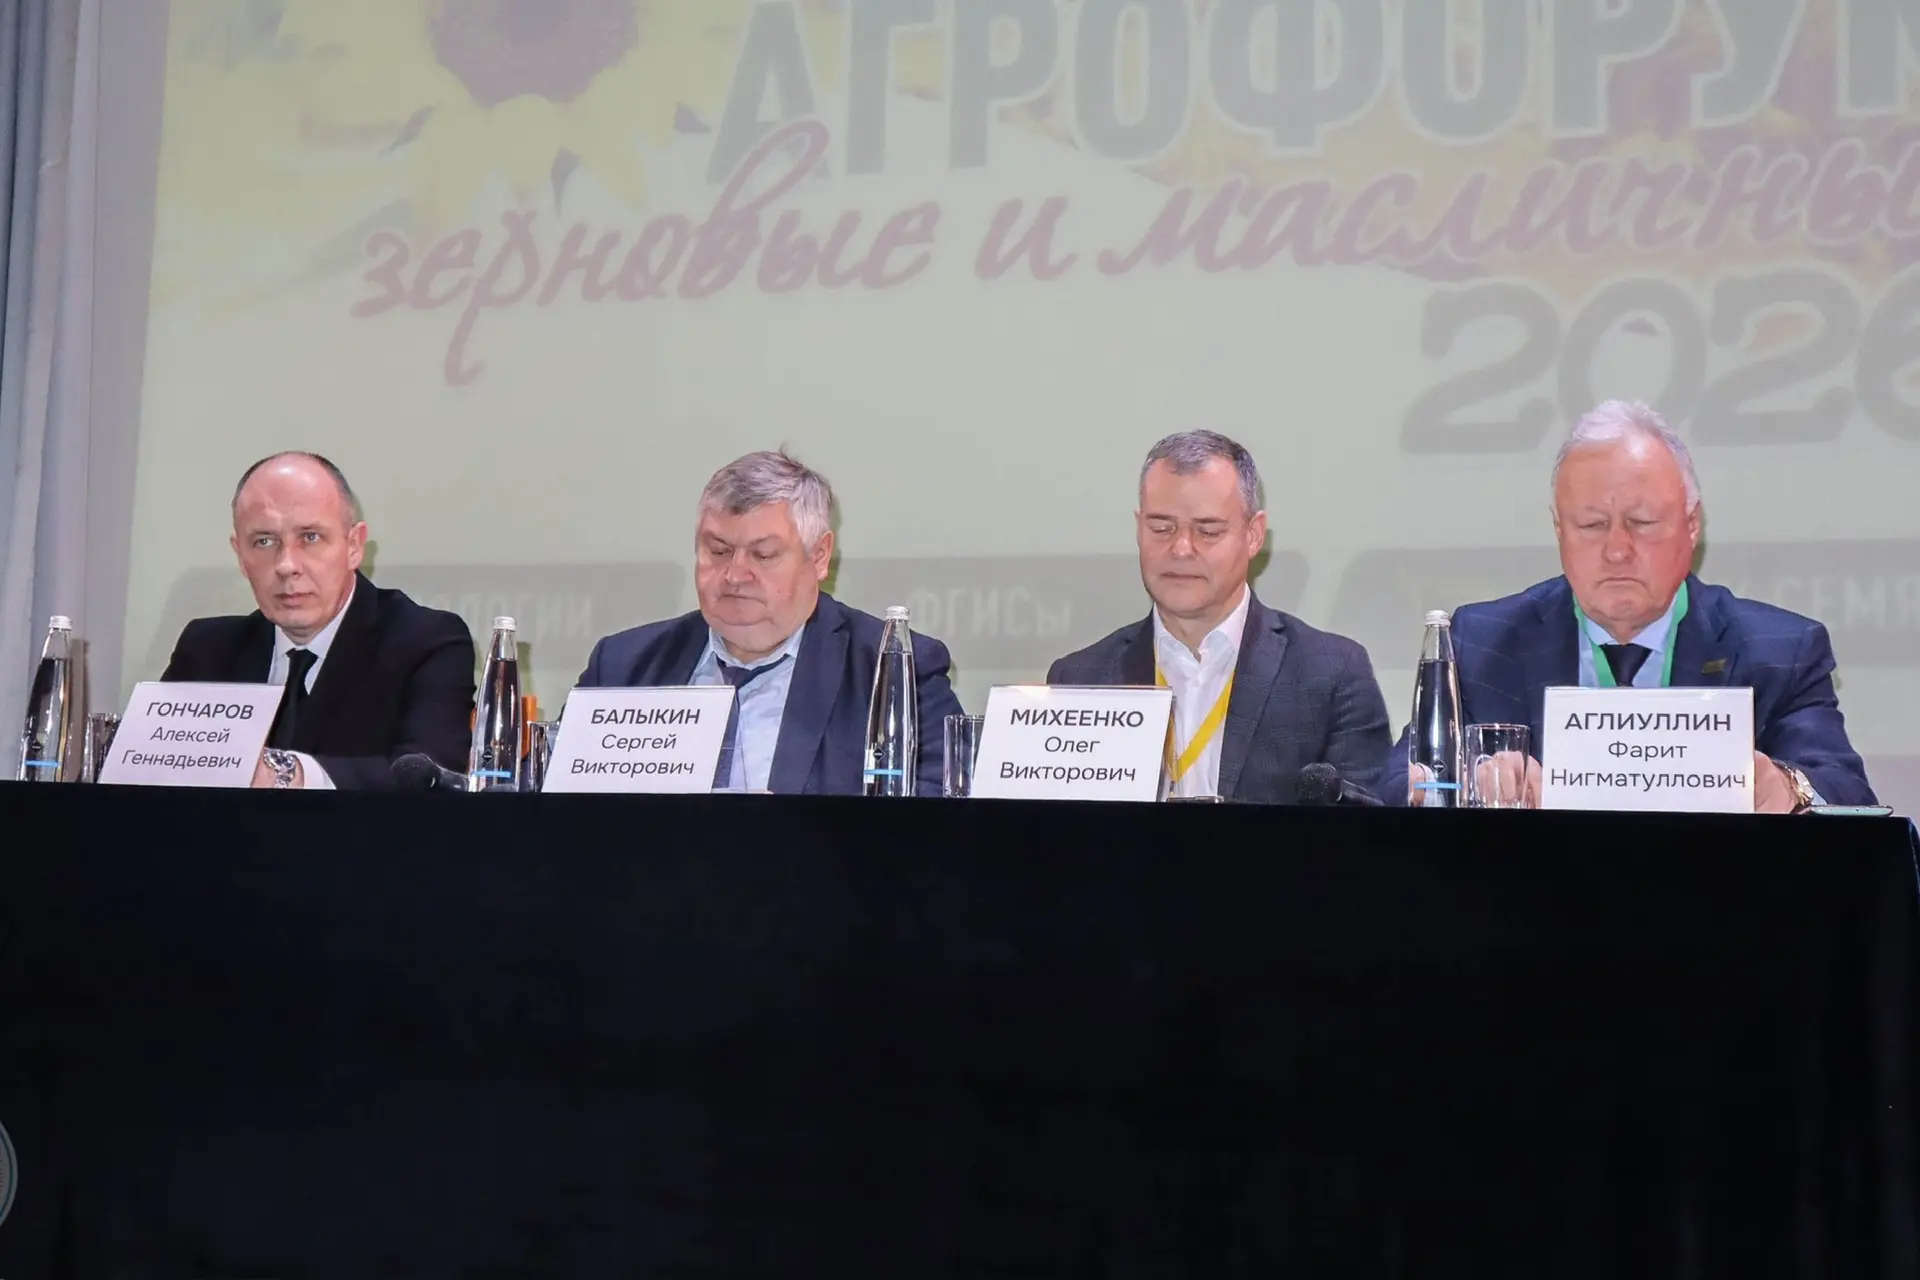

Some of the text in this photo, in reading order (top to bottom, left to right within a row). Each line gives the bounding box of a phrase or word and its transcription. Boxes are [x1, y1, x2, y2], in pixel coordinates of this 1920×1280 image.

[350, 116, 942, 388] зерновые
[974, 195, 1079, 282] и
[146, 702, 254, 720] ГОНЧАРОВ
[590, 708, 701, 725] БАЛЫКИН
[1010, 708, 1144, 728] МИХЕЕНКО
[1564, 712, 1731, 731] АГЛИУЛЛИН
[150, 726, 230, 743] Алексей
[601, 733, 677, 752] Сергей
[1044, 736, 1101, 753] Олег
[121, 749, 242, 769] Геннадьевич
[1608, 740, 1688, 761] Фарит
[570, 758, 695, 779] Викторович
[999, 761, 1136, 783] Викторович
[1551, 768, 1745, 791] Нигматуллович
